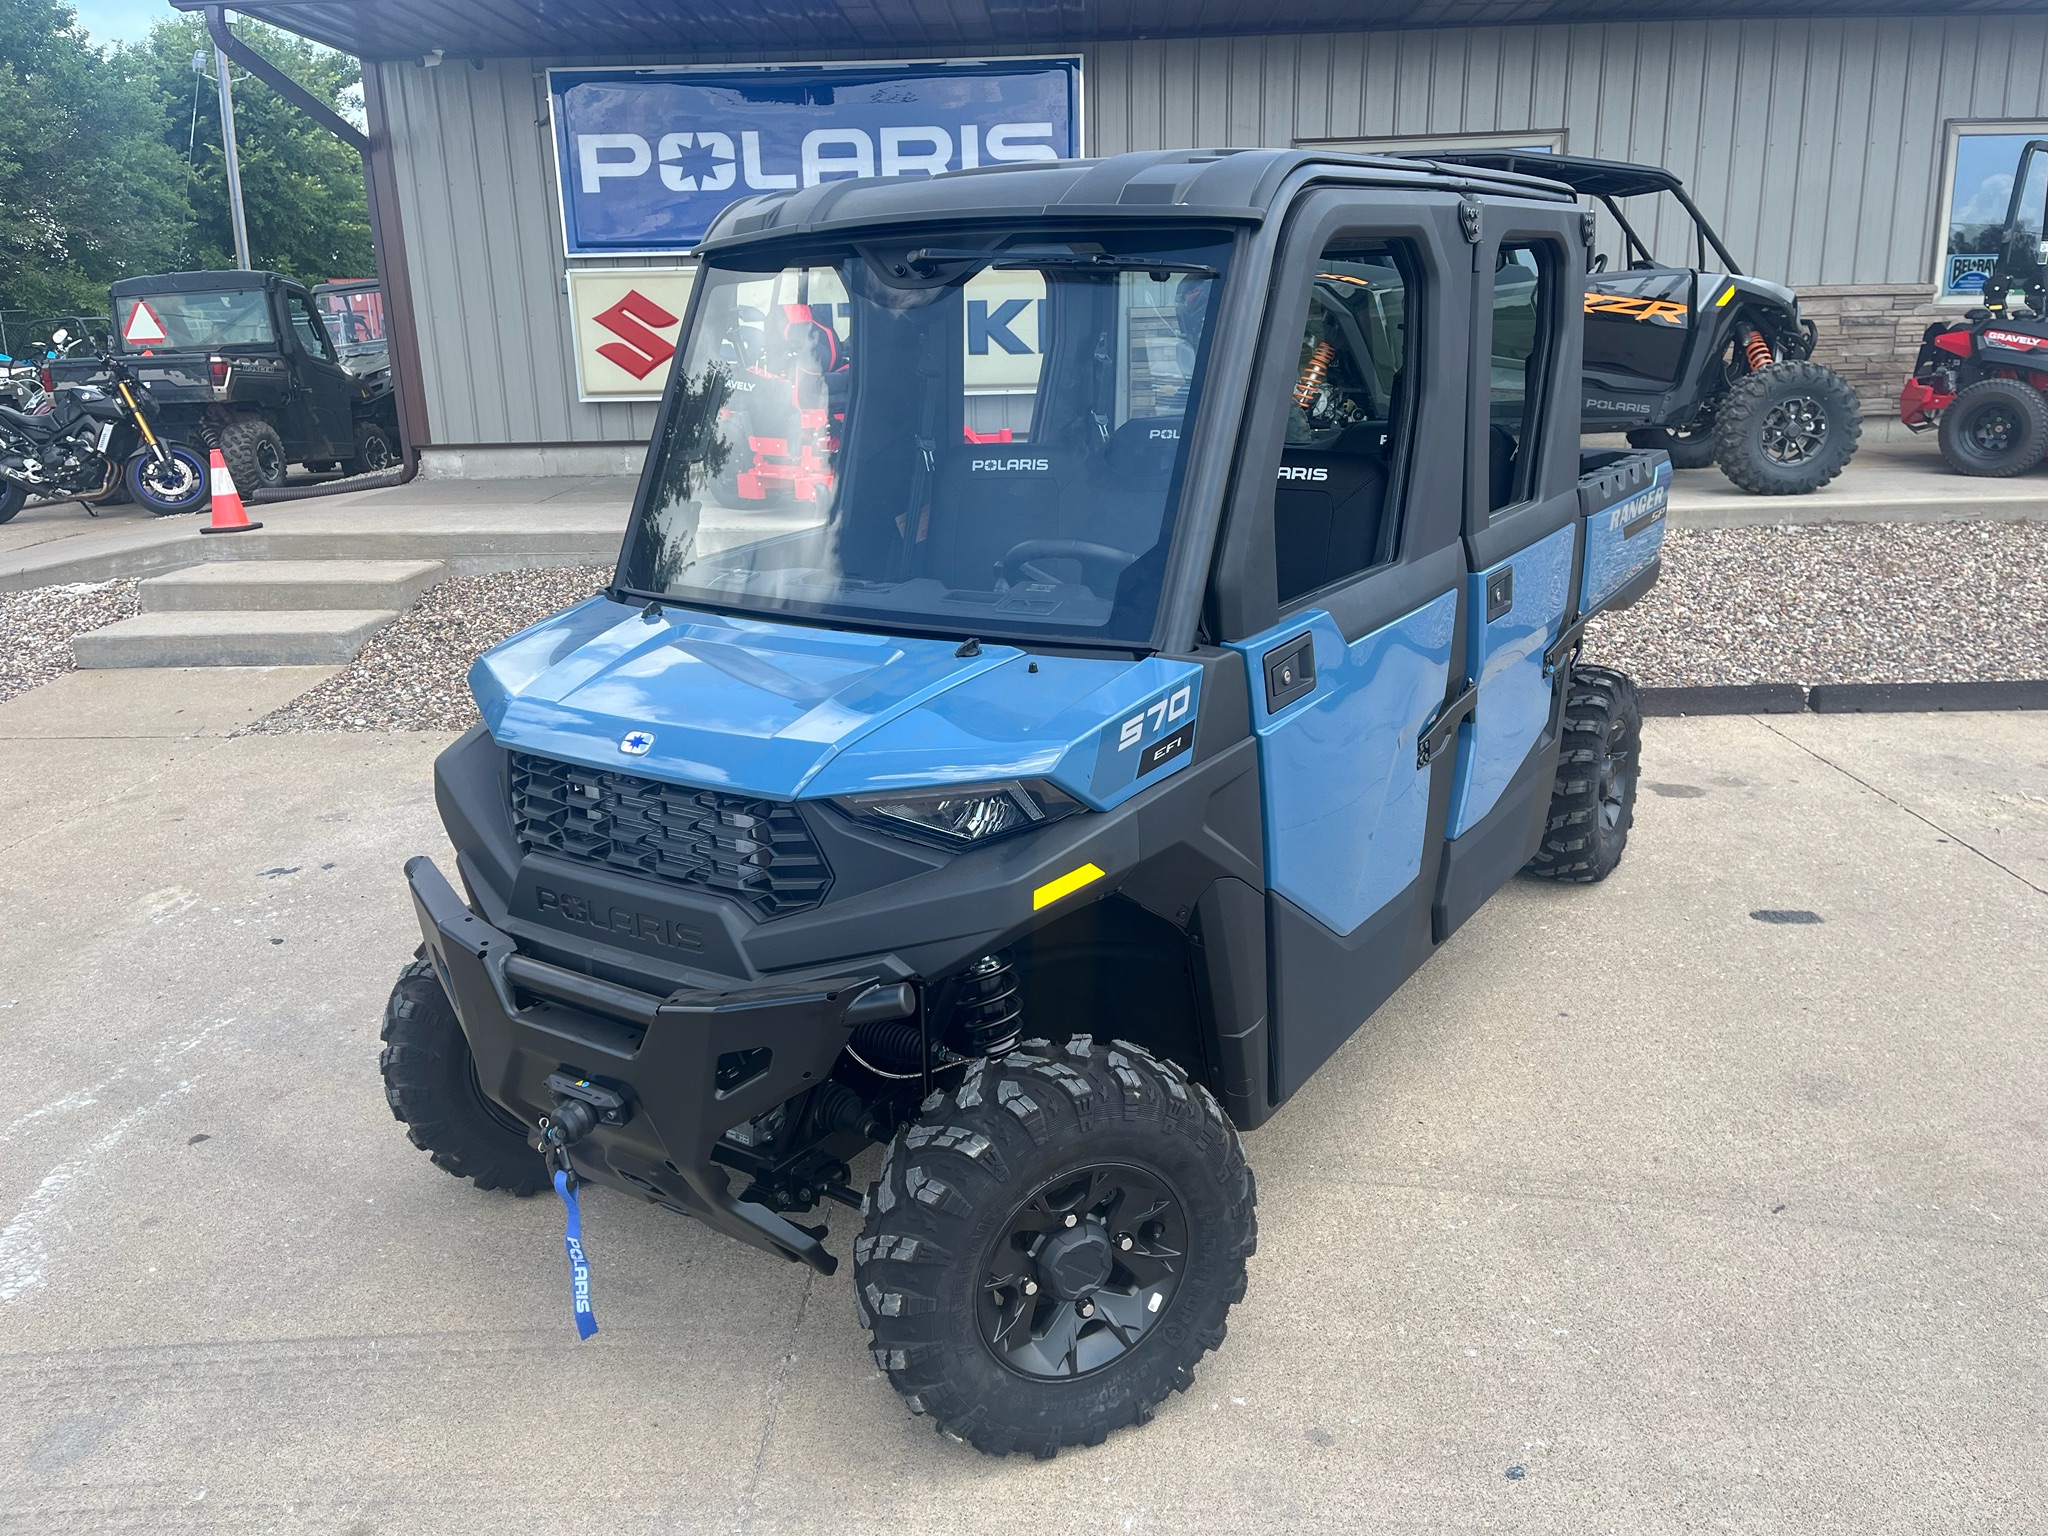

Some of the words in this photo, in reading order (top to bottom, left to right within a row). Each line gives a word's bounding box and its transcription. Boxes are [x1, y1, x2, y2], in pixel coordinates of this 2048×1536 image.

[577, 121, 1059, 193] POLARIS
[1988, 331, 2041, 346] GRAVELY
[1586, 398, 1651, 414] POLARIS
[971, 458, 1049, 472] POLARIS
[1609, 485, 1665, 532] RANGER
[1651, 506, 1666, 523] SP
[1153, 736, 1182, 761] EFI
[535, 885, 705, 955] POLARIS
[566, 1236, 591, 1314] POLARIS
